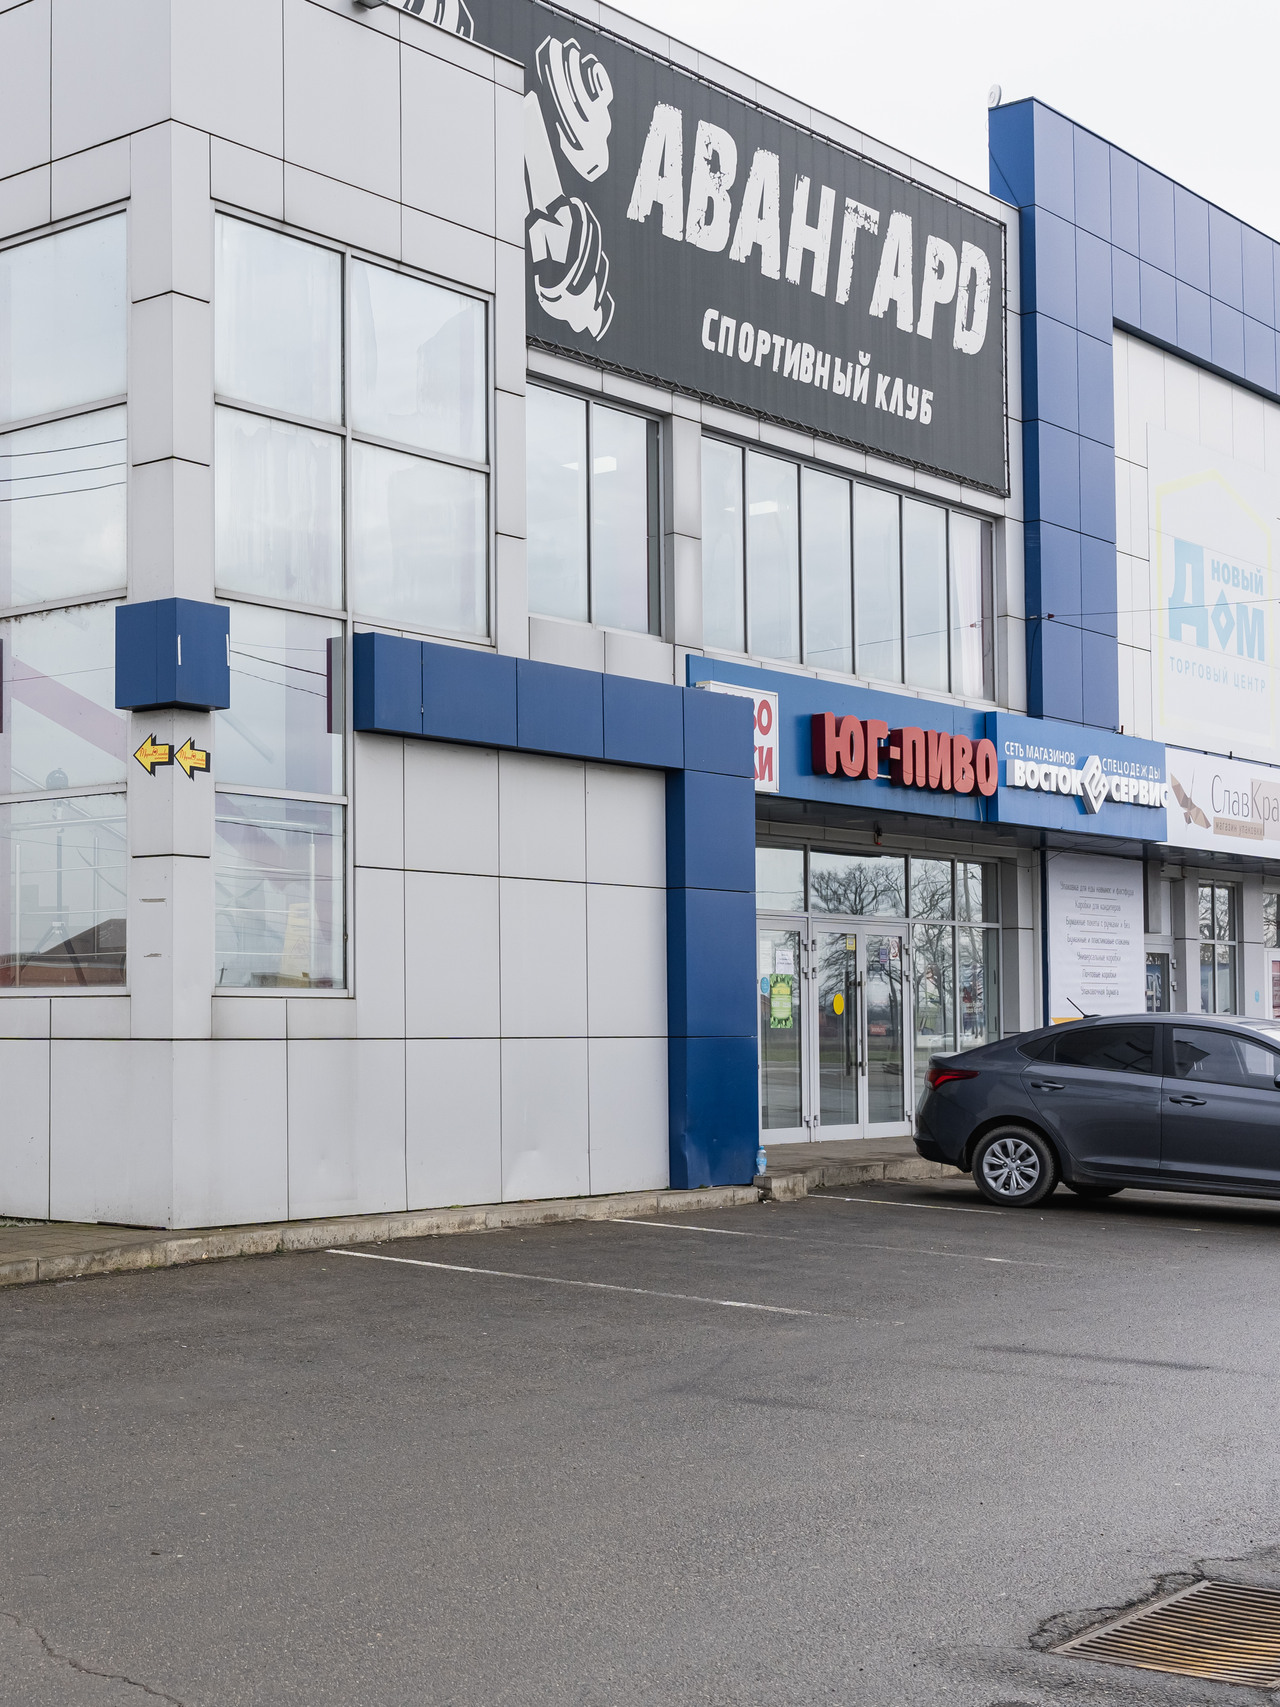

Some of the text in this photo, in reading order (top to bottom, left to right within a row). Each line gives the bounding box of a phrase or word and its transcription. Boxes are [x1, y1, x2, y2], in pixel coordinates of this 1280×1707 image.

[701, 308, 935, 425] СПОРТИВНЫЙ КЛУБ
[1211, 558, 1264, 596] НОВЫЙ
[1170, 656, 1266, 694] ТОРГОВЫЙ ЦЕНТР
[754, 699, 773, 736] О
[820, 711, 998, 796] ЮГ-ПИВО
[1004, 741, 1076, 765] СЕТЬ МАГАЗИНОВ
[1102, 757, 1161, 780] СПЕЦОДЕЖДЫ
[1011, 759, 1084, 797] ВОСТОК
[1215, 821, 1263, 836] магазин упаковки
